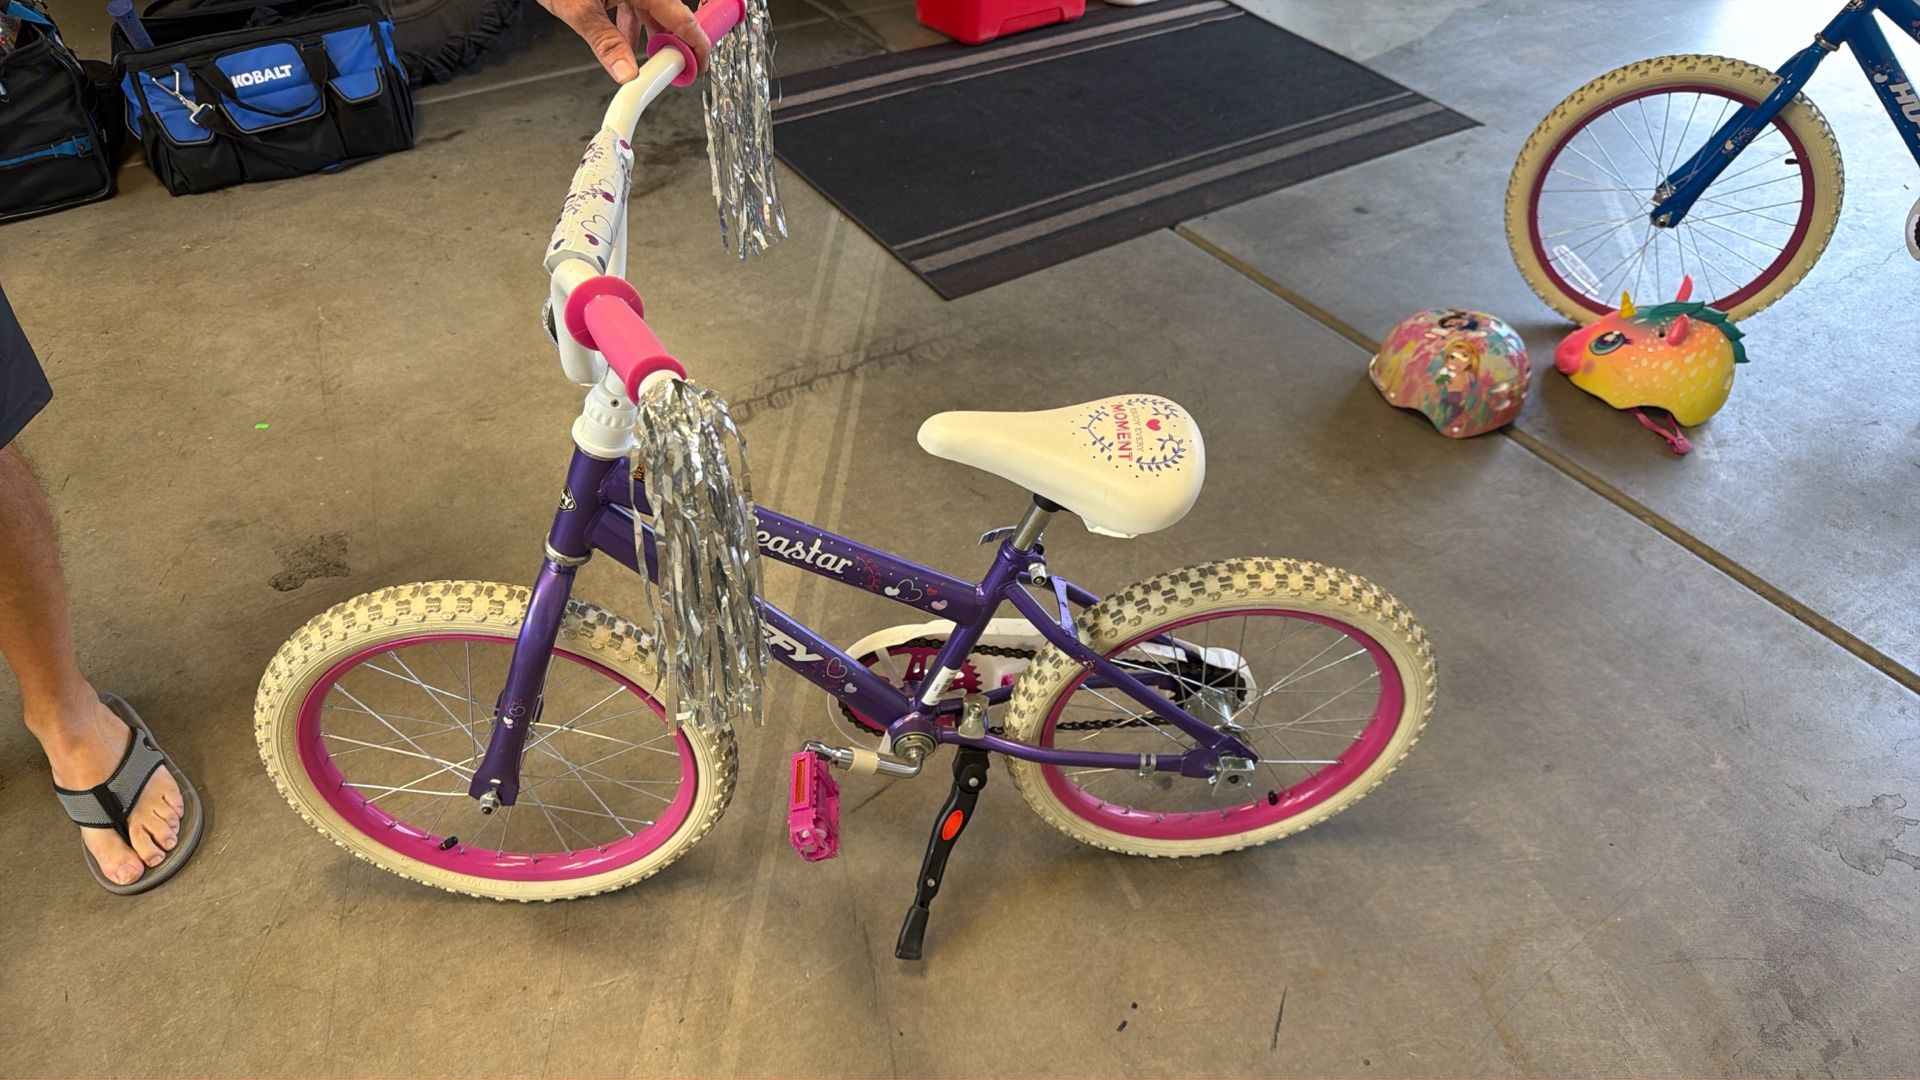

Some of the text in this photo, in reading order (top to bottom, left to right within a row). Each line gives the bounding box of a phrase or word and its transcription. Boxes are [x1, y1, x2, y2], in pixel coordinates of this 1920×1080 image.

[231, 64, 292, 89] KOBALT
[1110, 404, 1134, 462] MOMENT
[1134, 427, 1146, 453] EVERY
[753, 515, 854, 575] eastar
